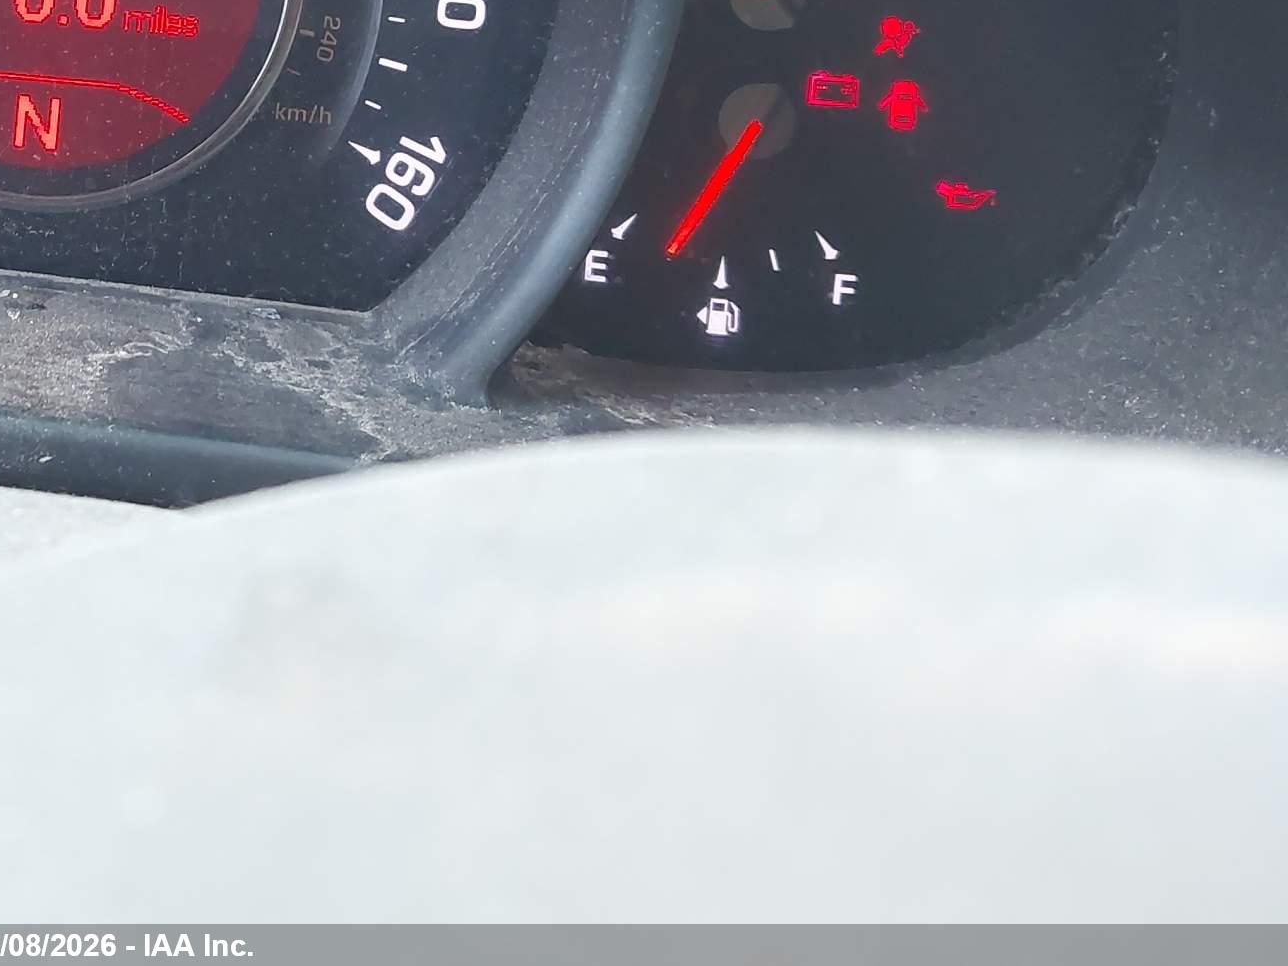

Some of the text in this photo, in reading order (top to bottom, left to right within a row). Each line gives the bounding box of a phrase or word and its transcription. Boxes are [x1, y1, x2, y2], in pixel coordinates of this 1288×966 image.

[122, 6, 200, 37] miles
[316, 15, 342, 64] 240
[13, 94, 63, 152] N
[274, 104, 332, 126] km/h
[365, 135, 448, 232] 160
[584, 250, 608, 283] E
[832, 273, 858, 305] F
